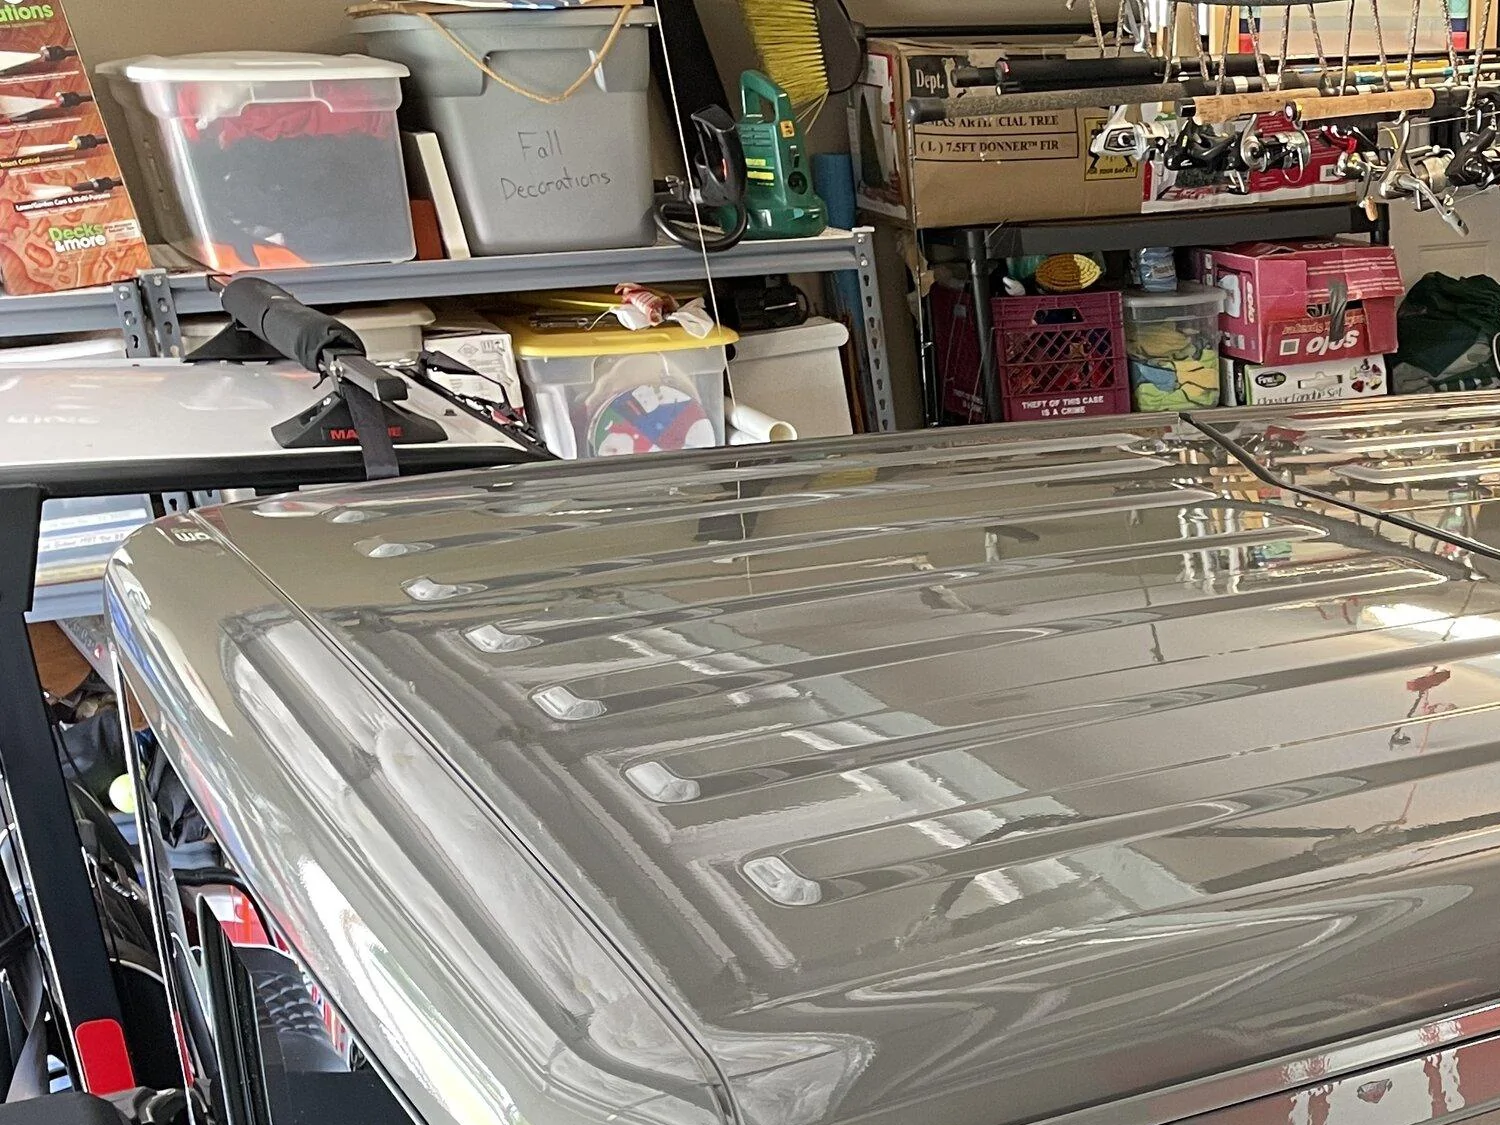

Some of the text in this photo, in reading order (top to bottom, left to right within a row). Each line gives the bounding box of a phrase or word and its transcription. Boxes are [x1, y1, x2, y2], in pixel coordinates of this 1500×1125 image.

[915, 68, 945, 94] Dept.
[1029, 114, 1059, 126] TREE
[517, 129, 563, 161] Fall
[946, 141, 976, 153] 7.5FT
[1040, 140, 1059, 150] FIR
[500, 166, 611, 200] Decorations
[48, 222, 104, 242] Decks
[54, 234, 107, 253] &more
[1022, 395, 1104, 410] THEFT OF THIS CASE
[1041, 406, 1086, 417] IS A CRIME
